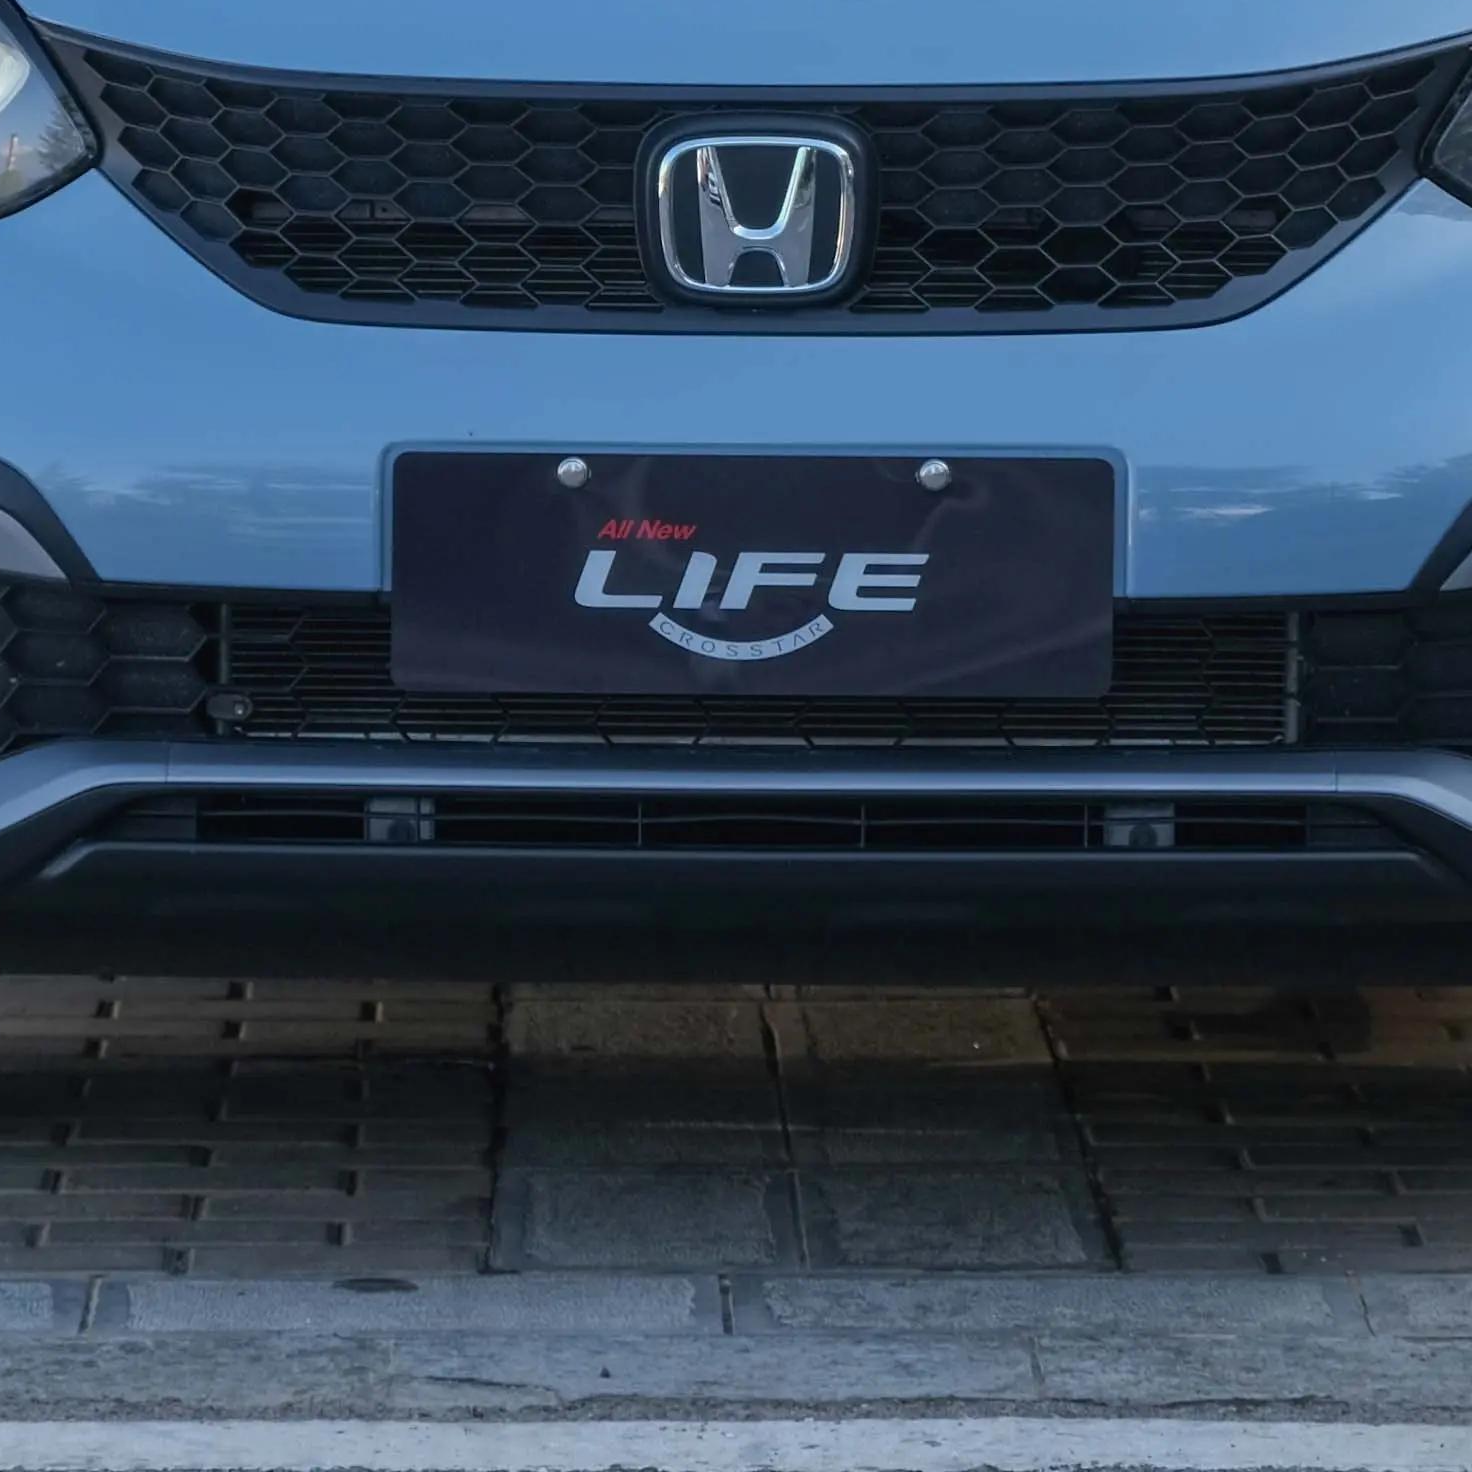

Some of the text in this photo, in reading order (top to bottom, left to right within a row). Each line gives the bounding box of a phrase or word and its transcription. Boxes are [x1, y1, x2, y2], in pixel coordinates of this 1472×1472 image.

[597, 519, 696, 540] All New
[574, 550, 930, 611] LIFE
[658, 620, 825, 658] CROSSTAR
